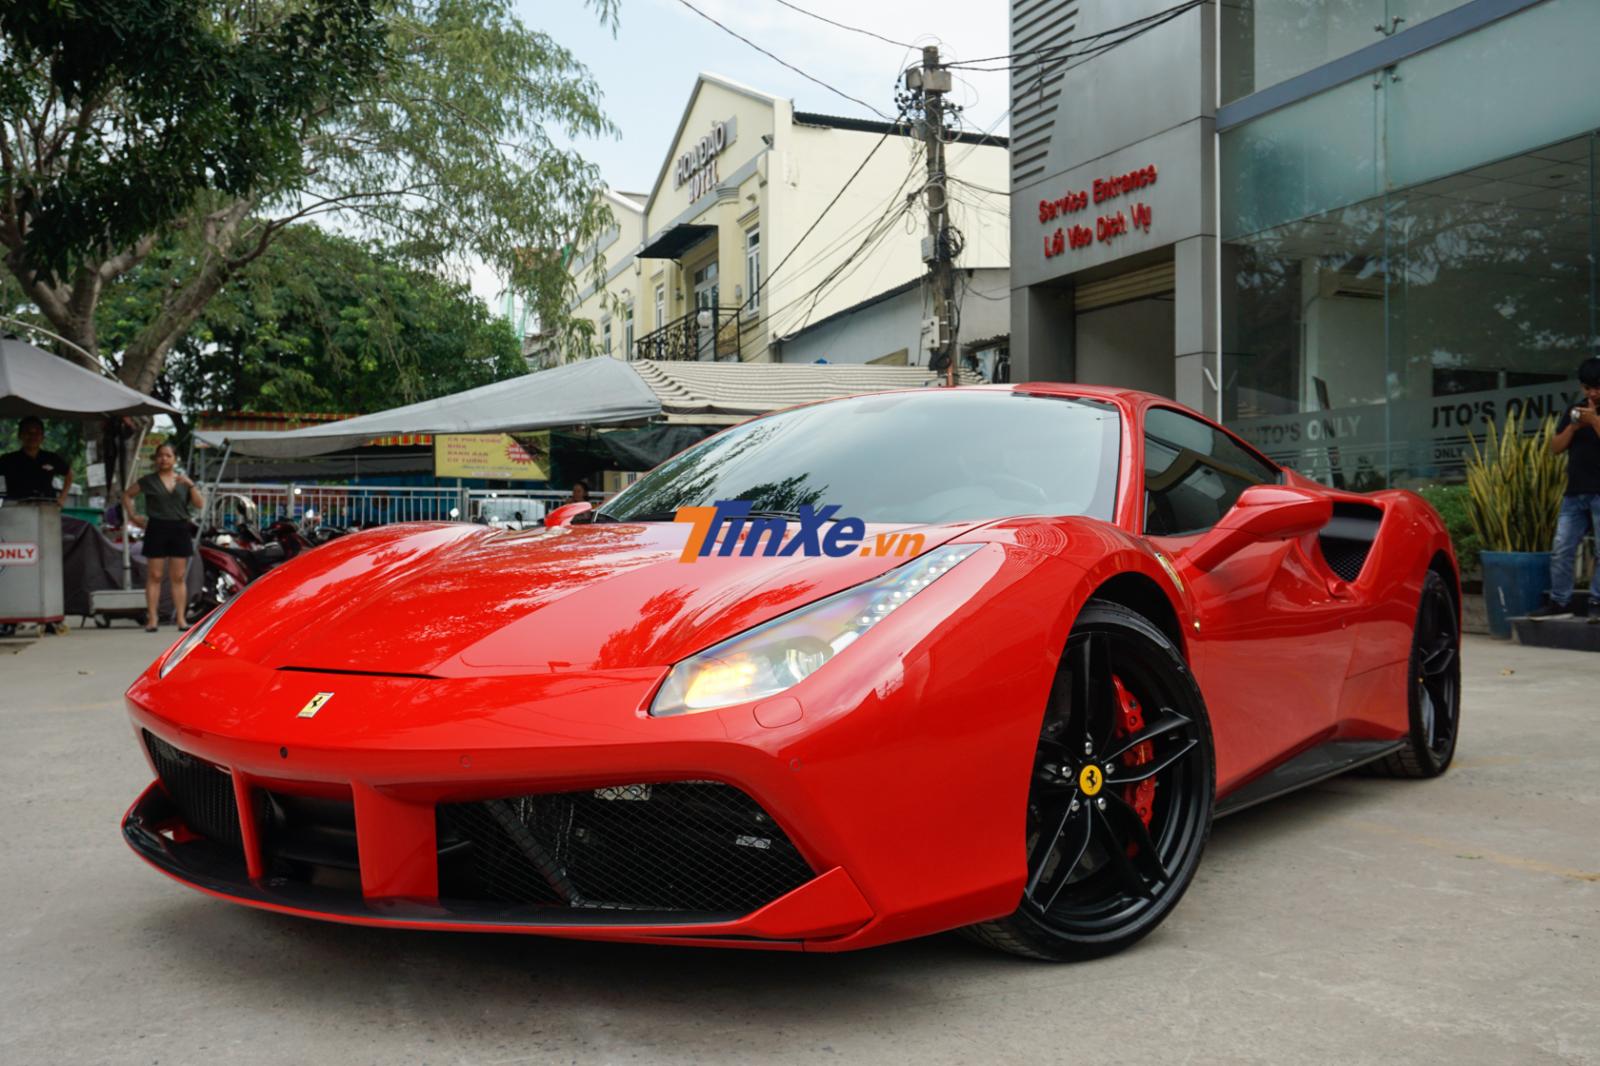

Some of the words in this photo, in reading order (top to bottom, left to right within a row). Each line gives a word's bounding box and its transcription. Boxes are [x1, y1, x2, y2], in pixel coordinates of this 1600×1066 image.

[1039, 191, 1088, 224] Service
[1093, 165, 1157, 205] Entrance
[1307, 415, 1361, 440] ONLY
